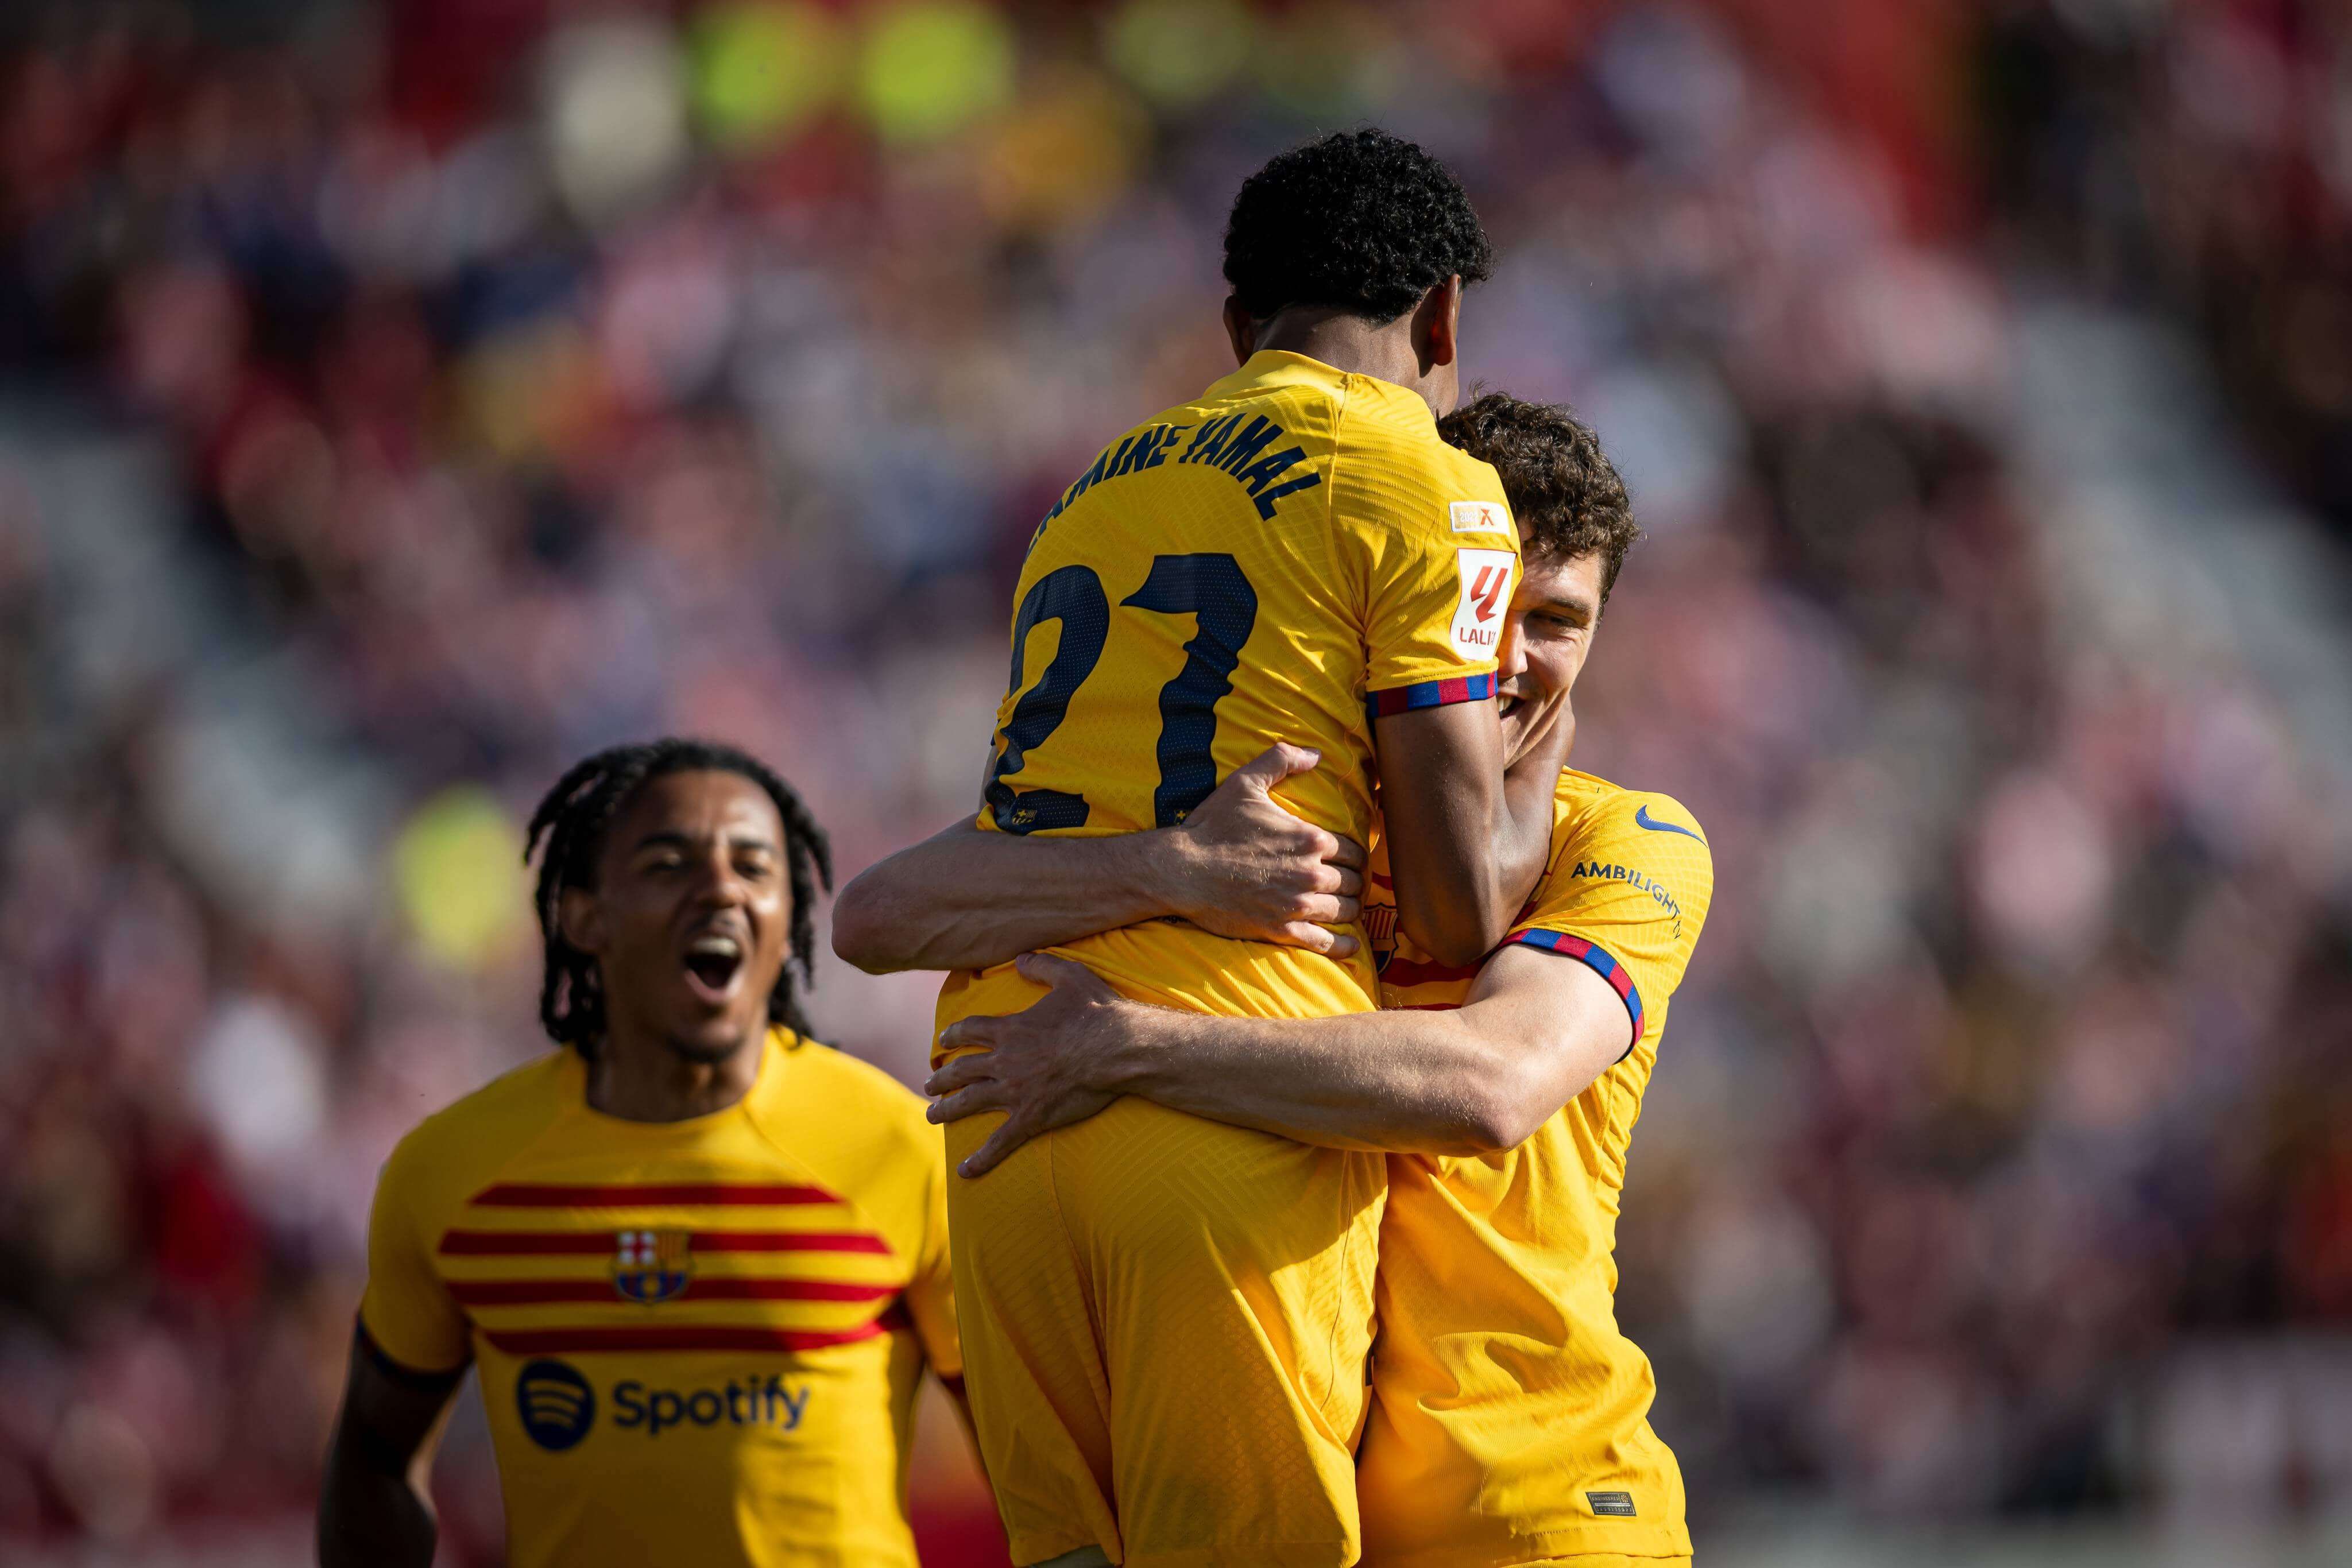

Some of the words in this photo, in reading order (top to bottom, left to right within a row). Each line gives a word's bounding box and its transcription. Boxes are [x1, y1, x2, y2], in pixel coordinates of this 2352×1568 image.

[1024, 424, 1196, 565] AMINE
[1178, 412, 1321, 521] YAMAL
[1460, 627, 1496, 646] LALI
[985, 552, 1258, 835] 27
[1570, 861, 1680, 920] AMBILIGHT
[612, 1375, 810, 1437] Spotify
